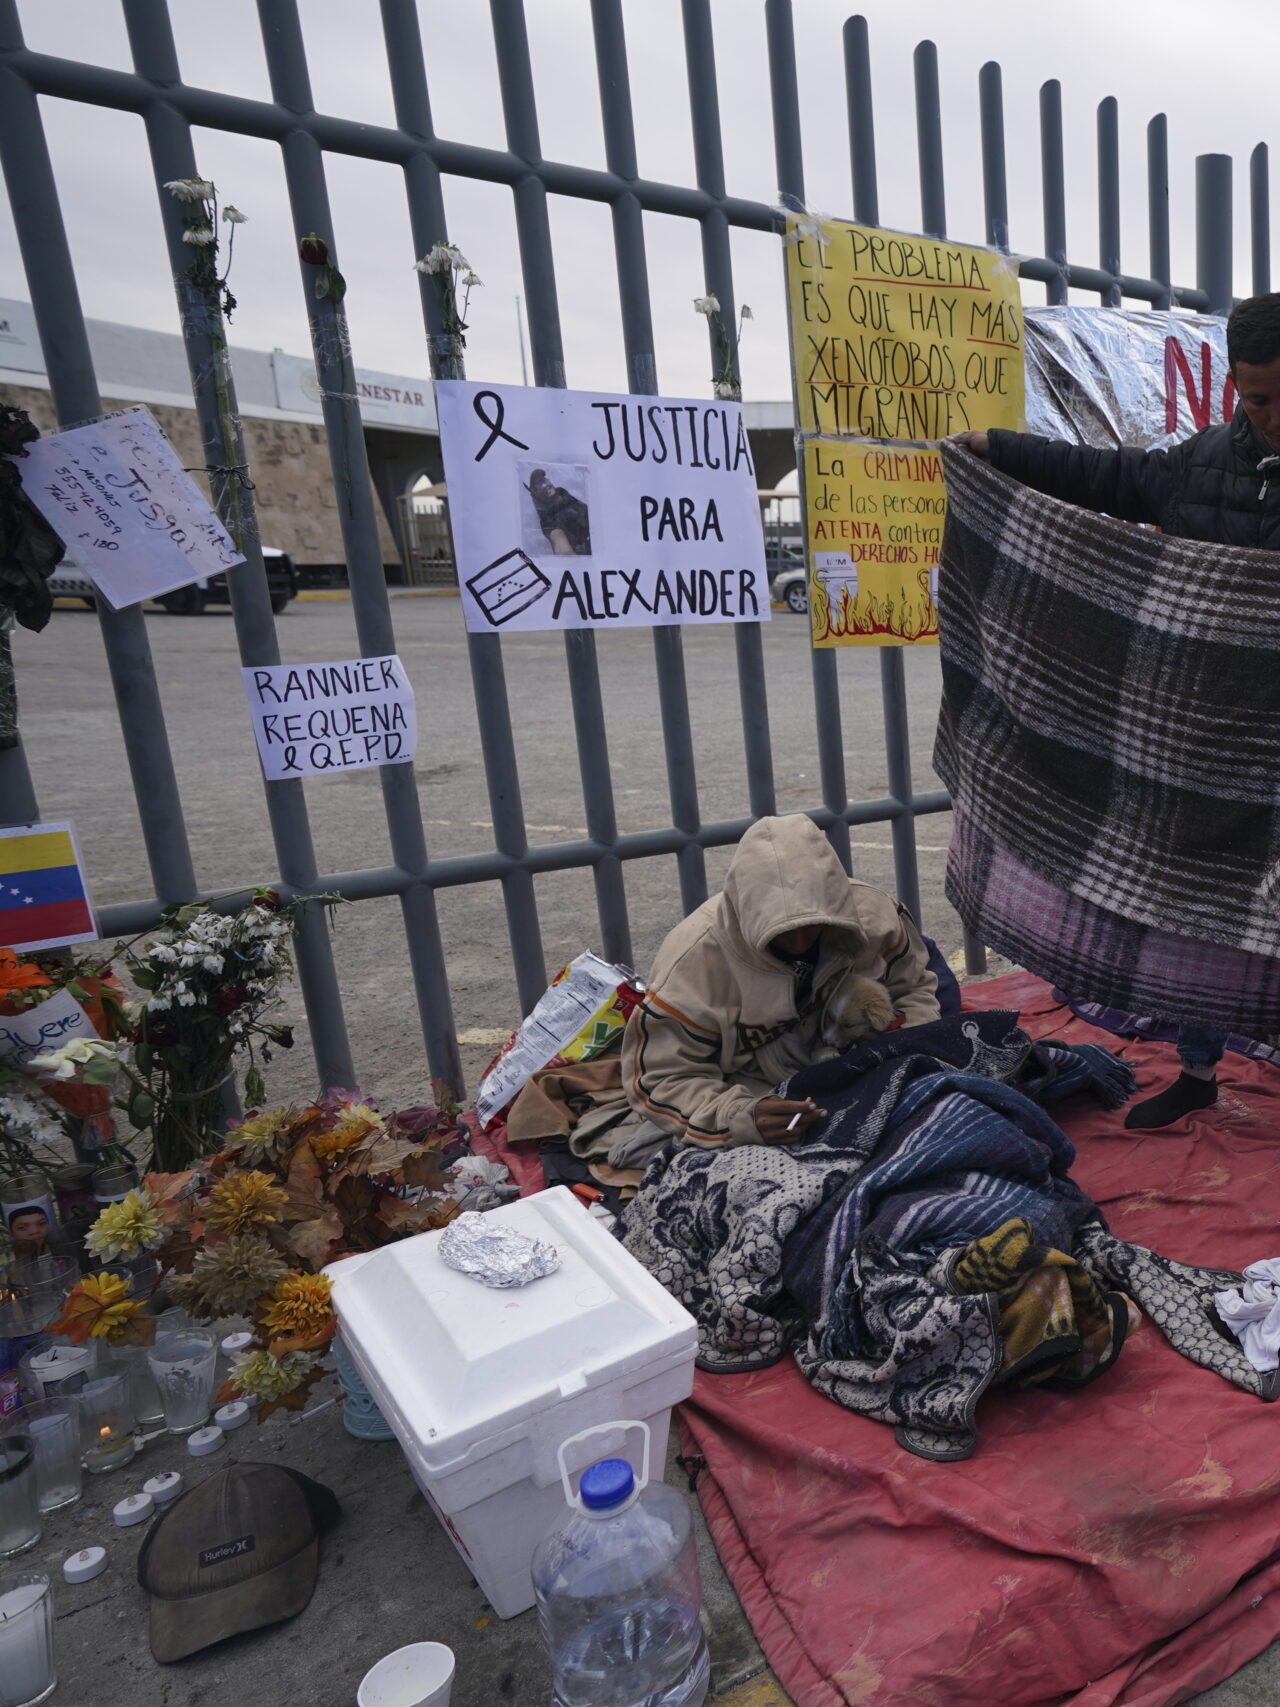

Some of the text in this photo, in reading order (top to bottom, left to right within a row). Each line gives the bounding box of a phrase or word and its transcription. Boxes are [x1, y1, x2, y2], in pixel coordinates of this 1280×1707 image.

[847, 229, 985, 289] PROBLEMA
[801, 280, 1020, 343] ES QUE HAY MÁS
[808, 335, 1007, 394] XENÓFOBOS QUE
[591, 403, 753, 476] JUSTICIA
[816, 447, 845, 478] La
[640, 496, 724, 542] PARA
[814, 484, 840, 513] de
[849, 485, 878, 514] las
[814, 520, 940, 544] ATENTA contra
[849, 544, 918, 564] DERECHOS
[552, 569, 758, 620] ALEXANDER
[262, 702, 408, 745] REQUENA
